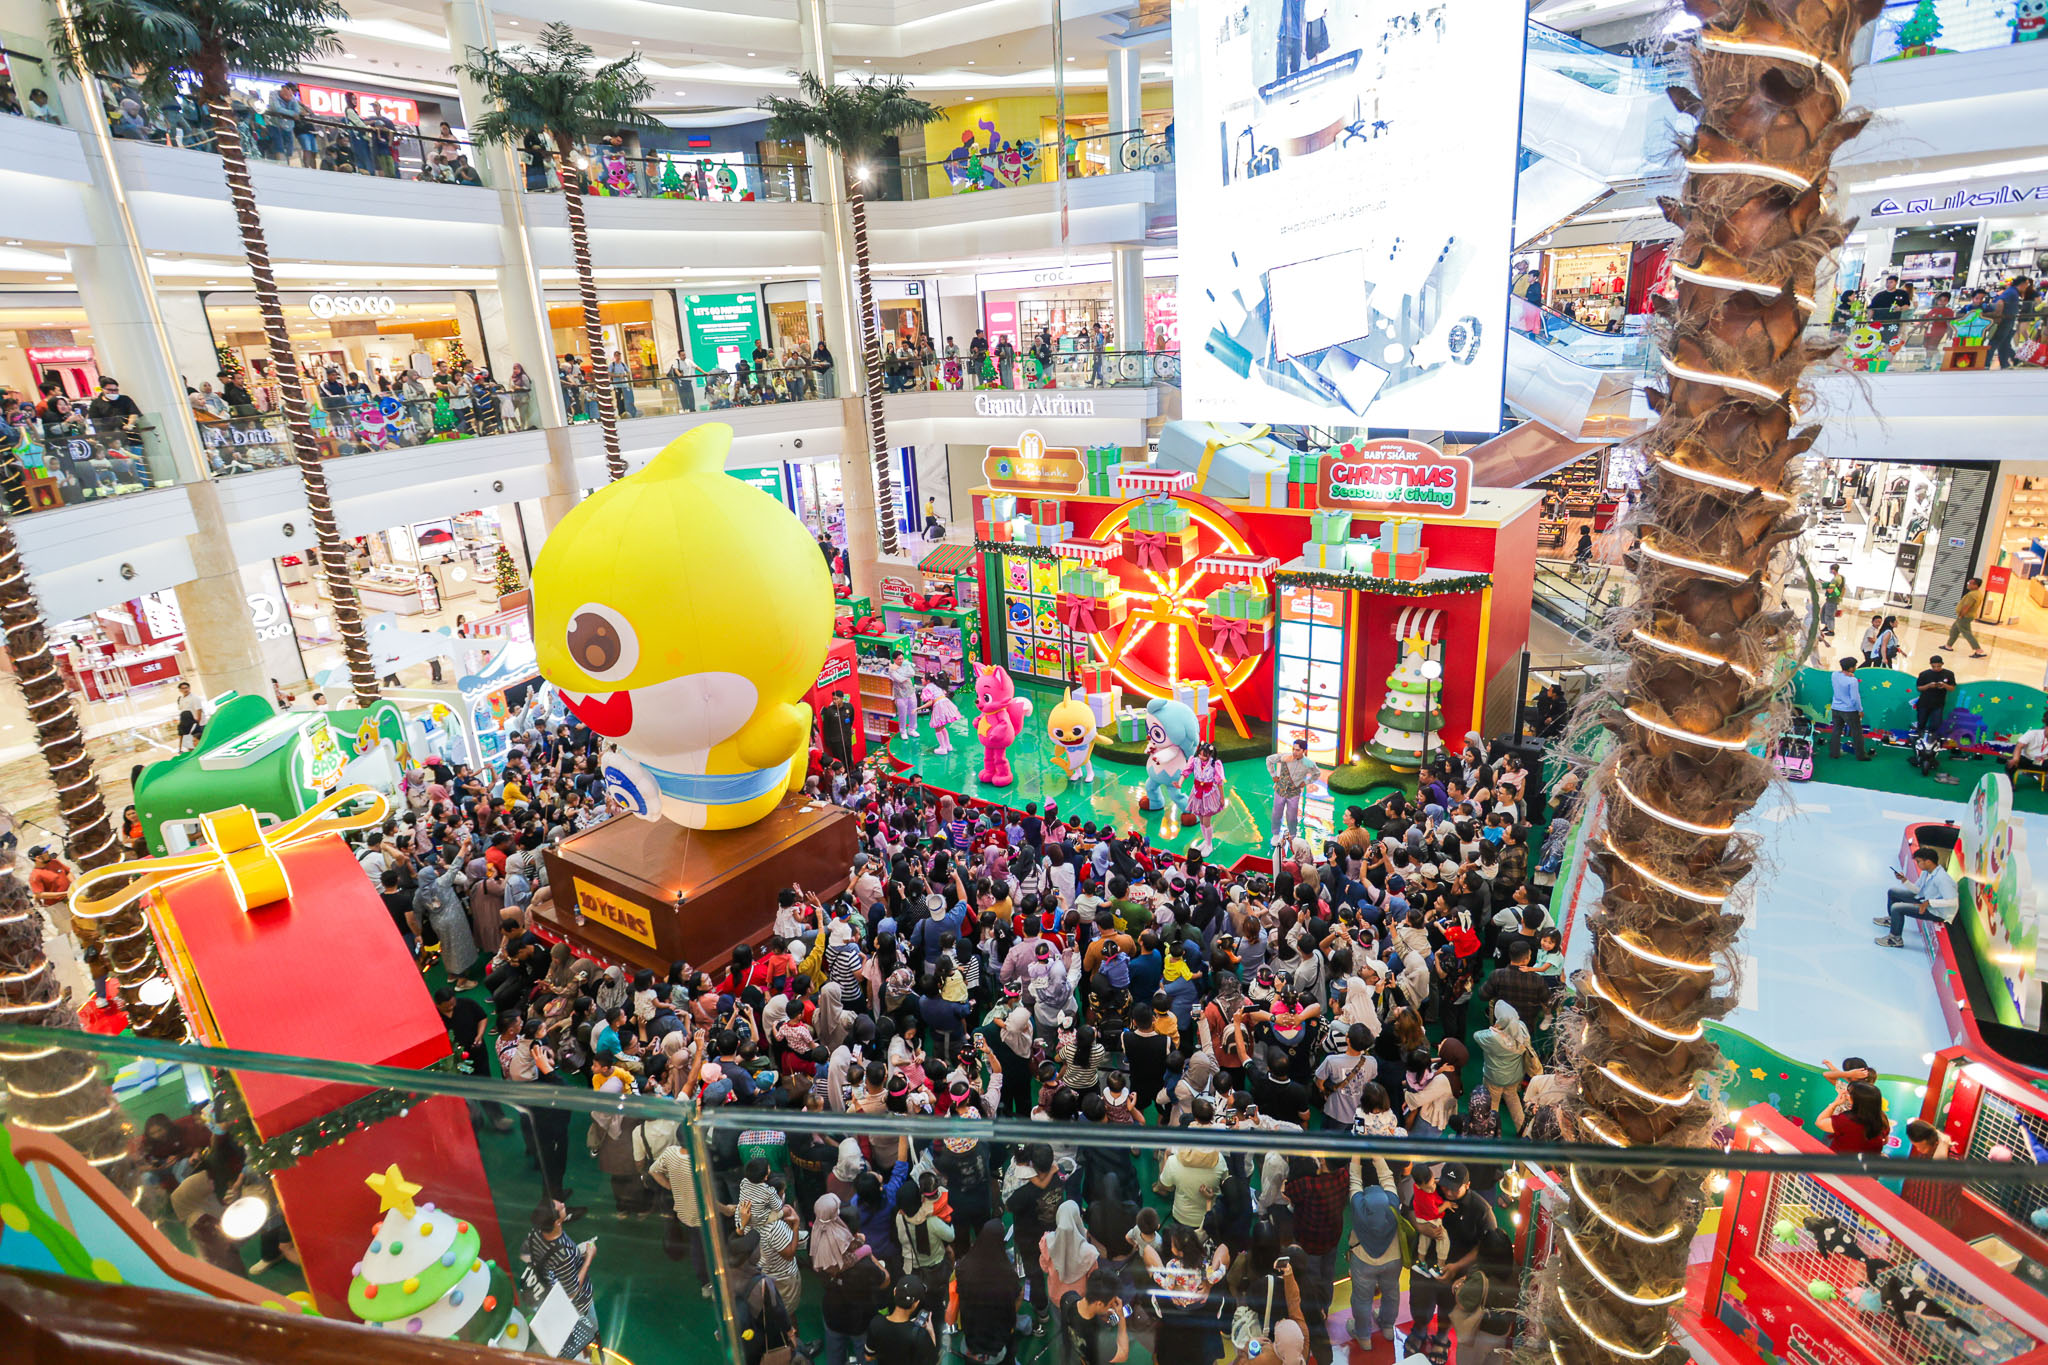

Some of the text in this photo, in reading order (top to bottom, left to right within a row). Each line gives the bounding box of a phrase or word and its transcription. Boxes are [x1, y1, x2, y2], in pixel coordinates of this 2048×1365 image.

[309, 88, 411, 124] DIECT
[334, 296, 395, 315] SOGO
[974, 393, 1095, 416] Grand Atrium
[1364, 447, 1418, 460] BABY SHARK
[1332, 464, 1454, 488] CHRISTMAS
[1331, 485, 1453, 507] Season of Giving
[255, 622, 293, 642] OGO
[596, 897, 649, 937] YEARS
